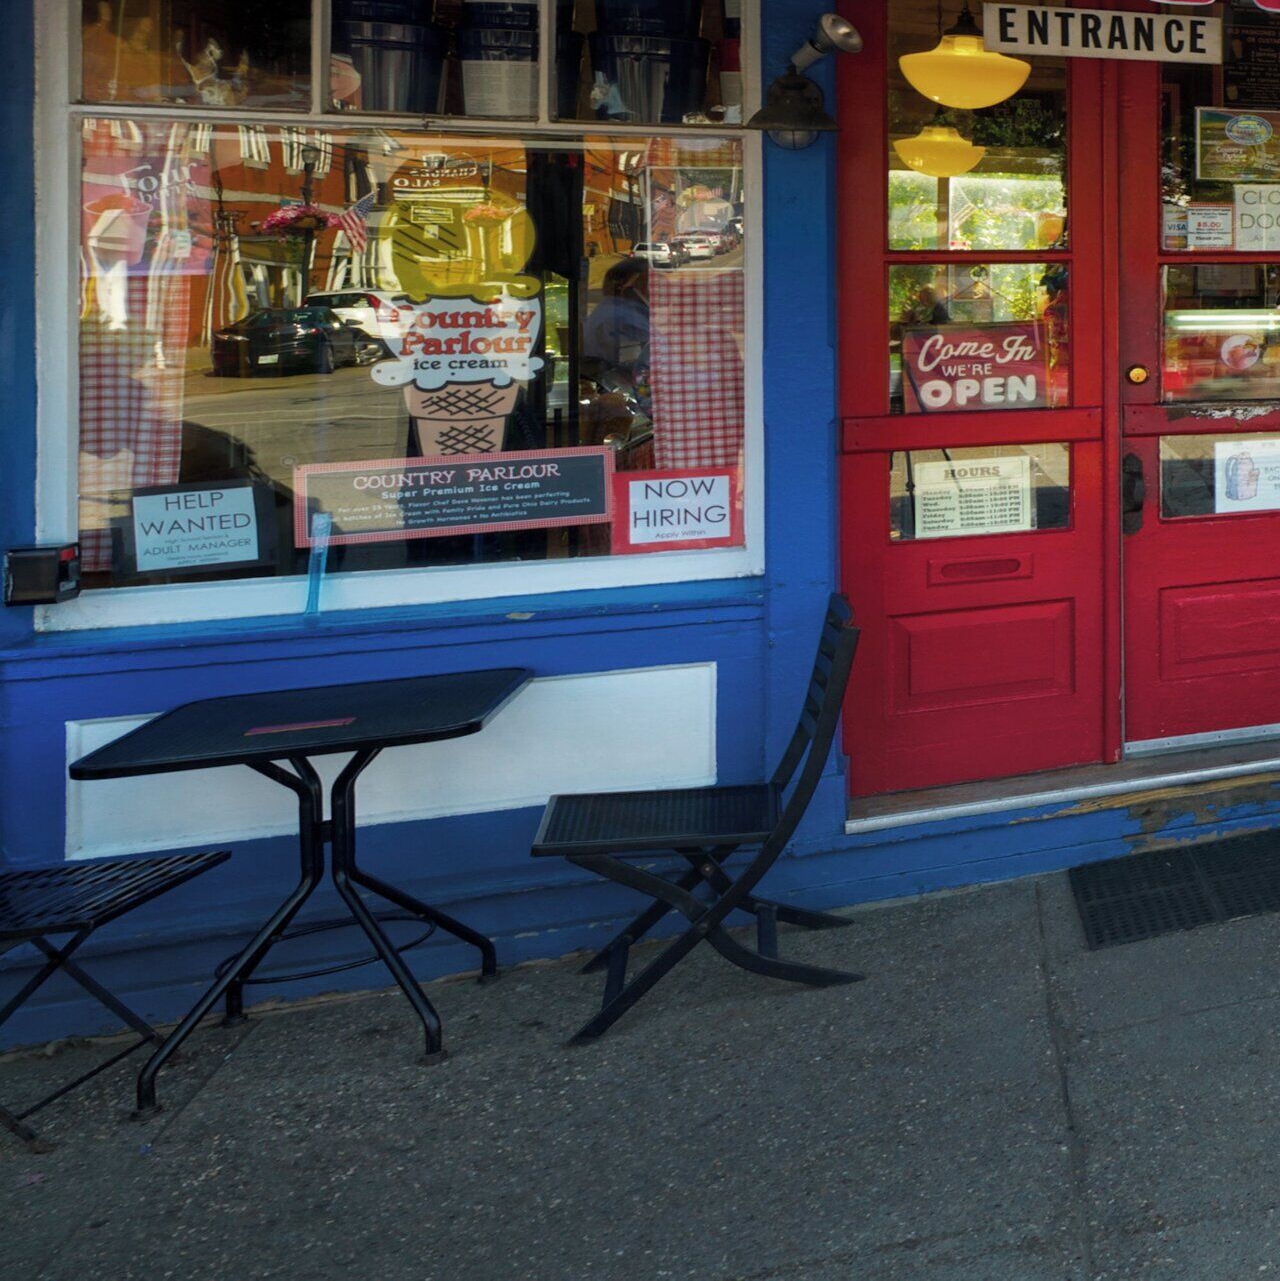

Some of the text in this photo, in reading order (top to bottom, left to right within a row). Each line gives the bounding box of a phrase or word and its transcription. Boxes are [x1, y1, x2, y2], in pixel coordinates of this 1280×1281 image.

[998, 7, 1207, 54] ENTRANCE
[398, 330, 532, 356] Parlour
[917, 334, 1037, 373] Come In
[413, 357, 509, 370] ice cream
[941, 363, 993, 377] WE'RE
[919, 374, 1037, 408] OPEN
[353, 463, 562, 490] COUNTRY PARLOUR
[943, 465, 1001, 479] HOURS
[381, 481, 541, 500] Super Premium Ice Cream
[644, 478, 716, 500] NOW
[164, 491, 224, 512] HELP
[140, 512, 252, 536] WANTED
[633, 505, 727, 528] HIRING
[655, 531, 680, 539] Apply
[143, 544, 181, 556] ADULT
[188, 538, 251, 552] MANAGER
